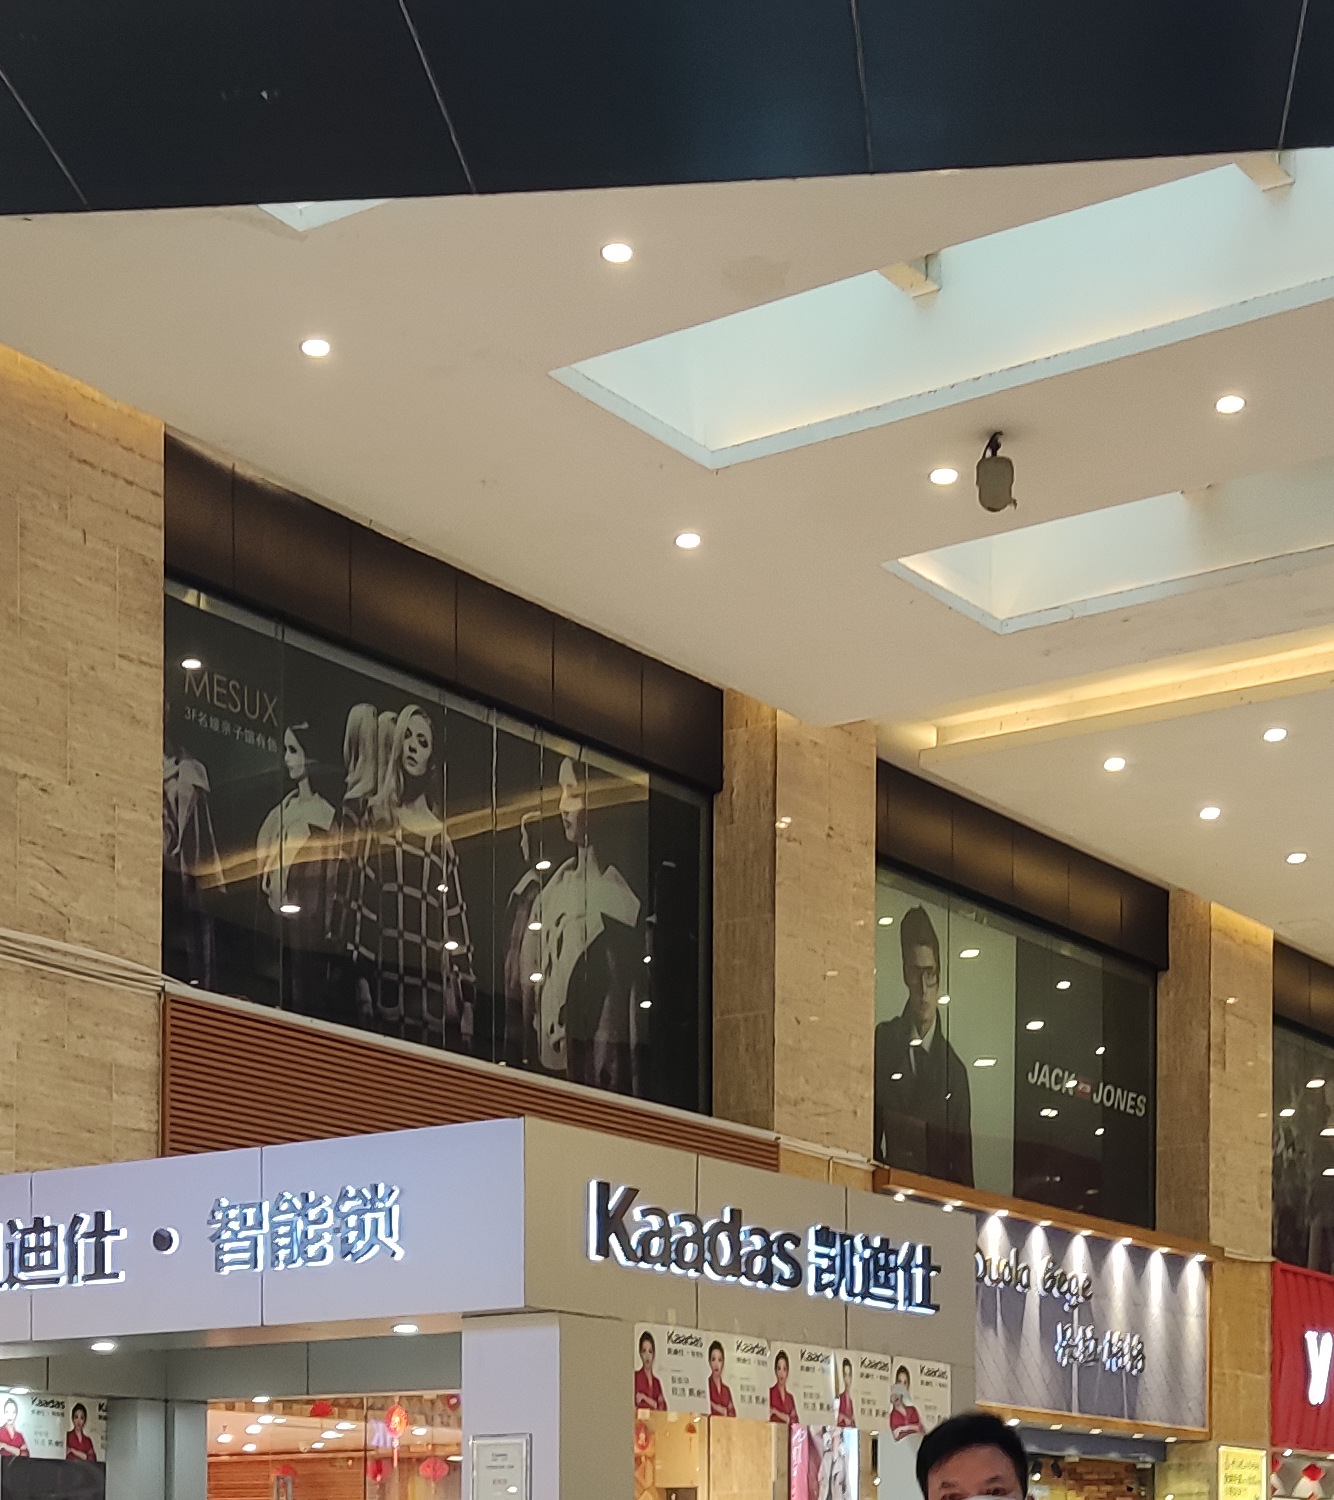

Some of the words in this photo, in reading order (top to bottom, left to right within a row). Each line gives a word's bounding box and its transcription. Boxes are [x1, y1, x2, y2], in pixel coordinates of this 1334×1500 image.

[185, 671, 278, 727] MESUX
[1028, 1061, 1077, 1096] JACK
[1092, 1082, 1147, 1117] JONES
[207, 1182, 405, 1276] 智能锁
[587, 1179, 802, 1291] Kaadas
[806, 1223, 942, 1316] 凯迪仕
